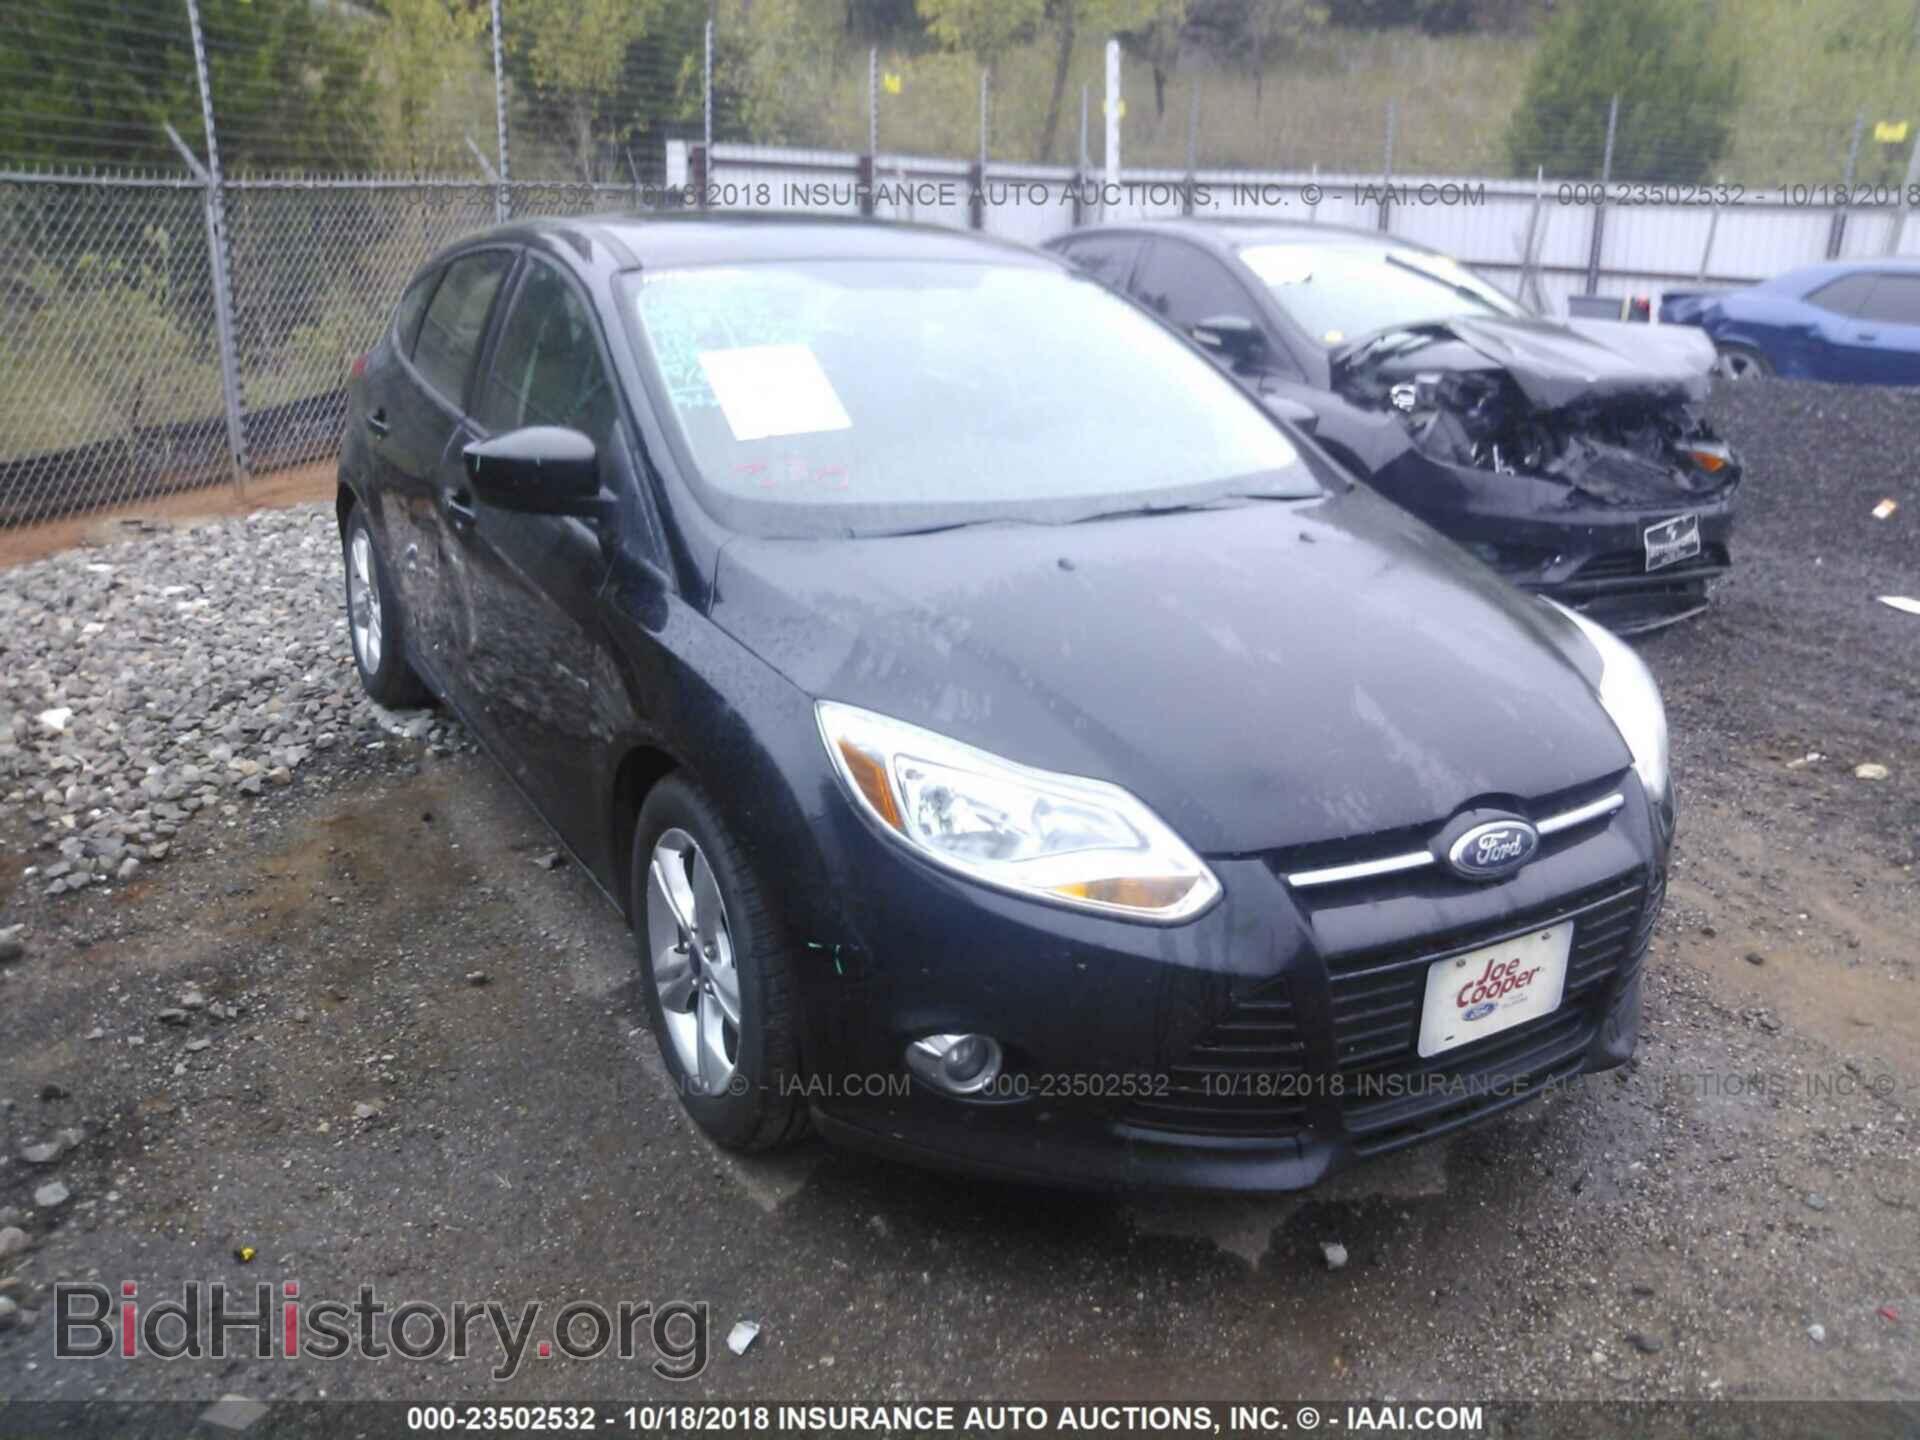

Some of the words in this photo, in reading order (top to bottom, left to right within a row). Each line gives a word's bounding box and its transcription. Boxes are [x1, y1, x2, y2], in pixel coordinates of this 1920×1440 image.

[1476, 830, 1521, 865] Ford
[1456, 966, 1538, 1008] Cooper
[1476, 957, 1521, 986] Joe
